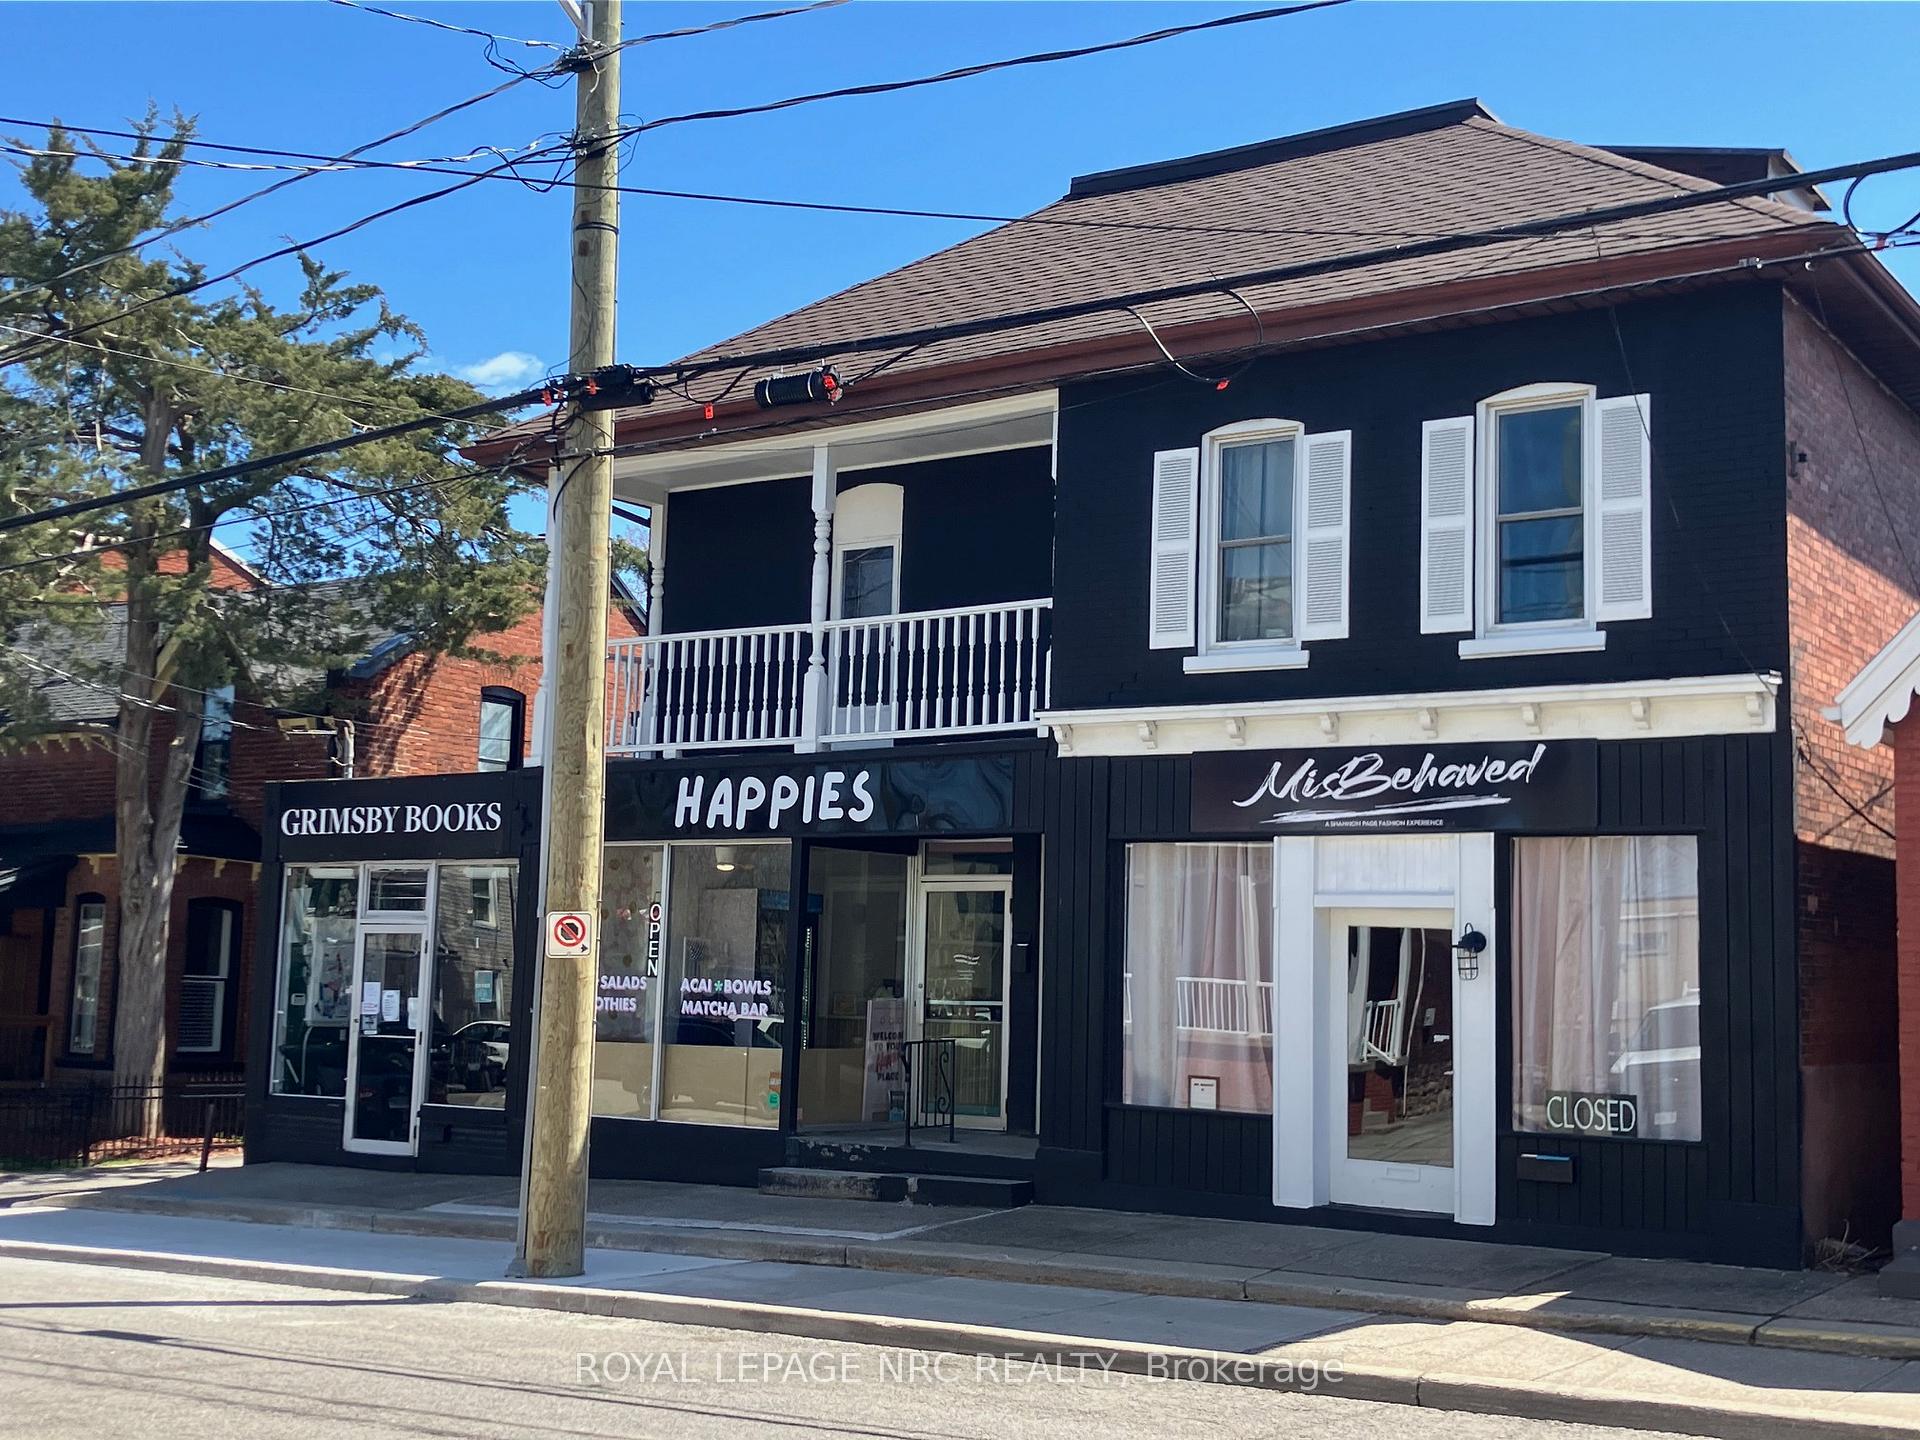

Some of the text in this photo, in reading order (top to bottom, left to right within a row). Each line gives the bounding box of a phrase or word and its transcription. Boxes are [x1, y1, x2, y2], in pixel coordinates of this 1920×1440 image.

[1232, 743, 1546, 807] MisBehaved
[674, 770, 874, 830] HAPPIES
[281, 802, 502, 836] GRIMSBY BOOKS
[647, 904, 661, 976] OPEN
[600, 975, 648, 990] SALADS
[724, 979, 772, 996] BOWLS
[681, 1000, 769, 1017] MATCHA BAR
[1546, 1096, 1636, 1132] CLOSED
